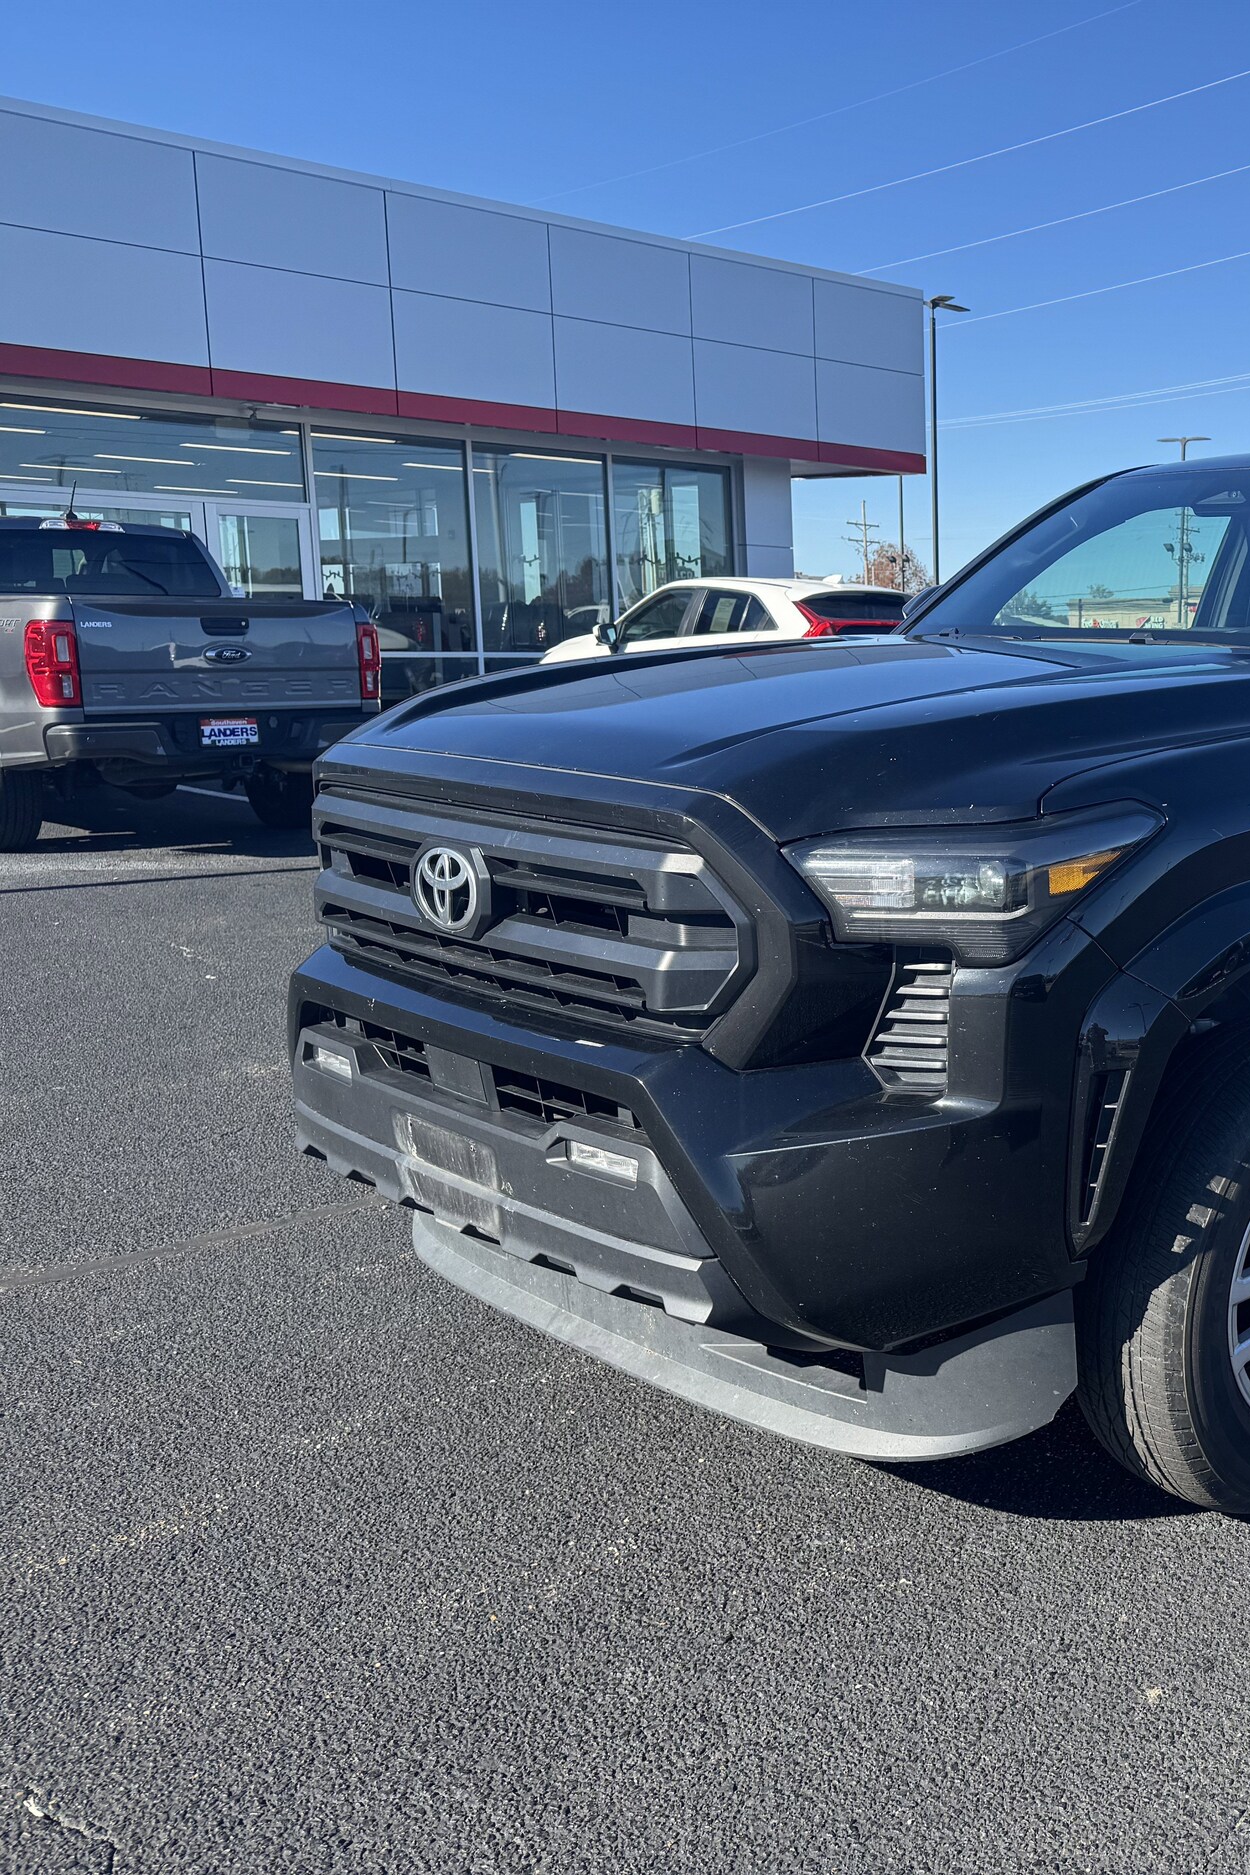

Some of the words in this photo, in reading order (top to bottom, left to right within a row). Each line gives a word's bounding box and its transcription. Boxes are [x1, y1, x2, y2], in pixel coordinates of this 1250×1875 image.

[222, 650, 241, 659] Ford
[92, 679, 353, 699] RANGER
[201, 727, 258, 739] LANDERS
